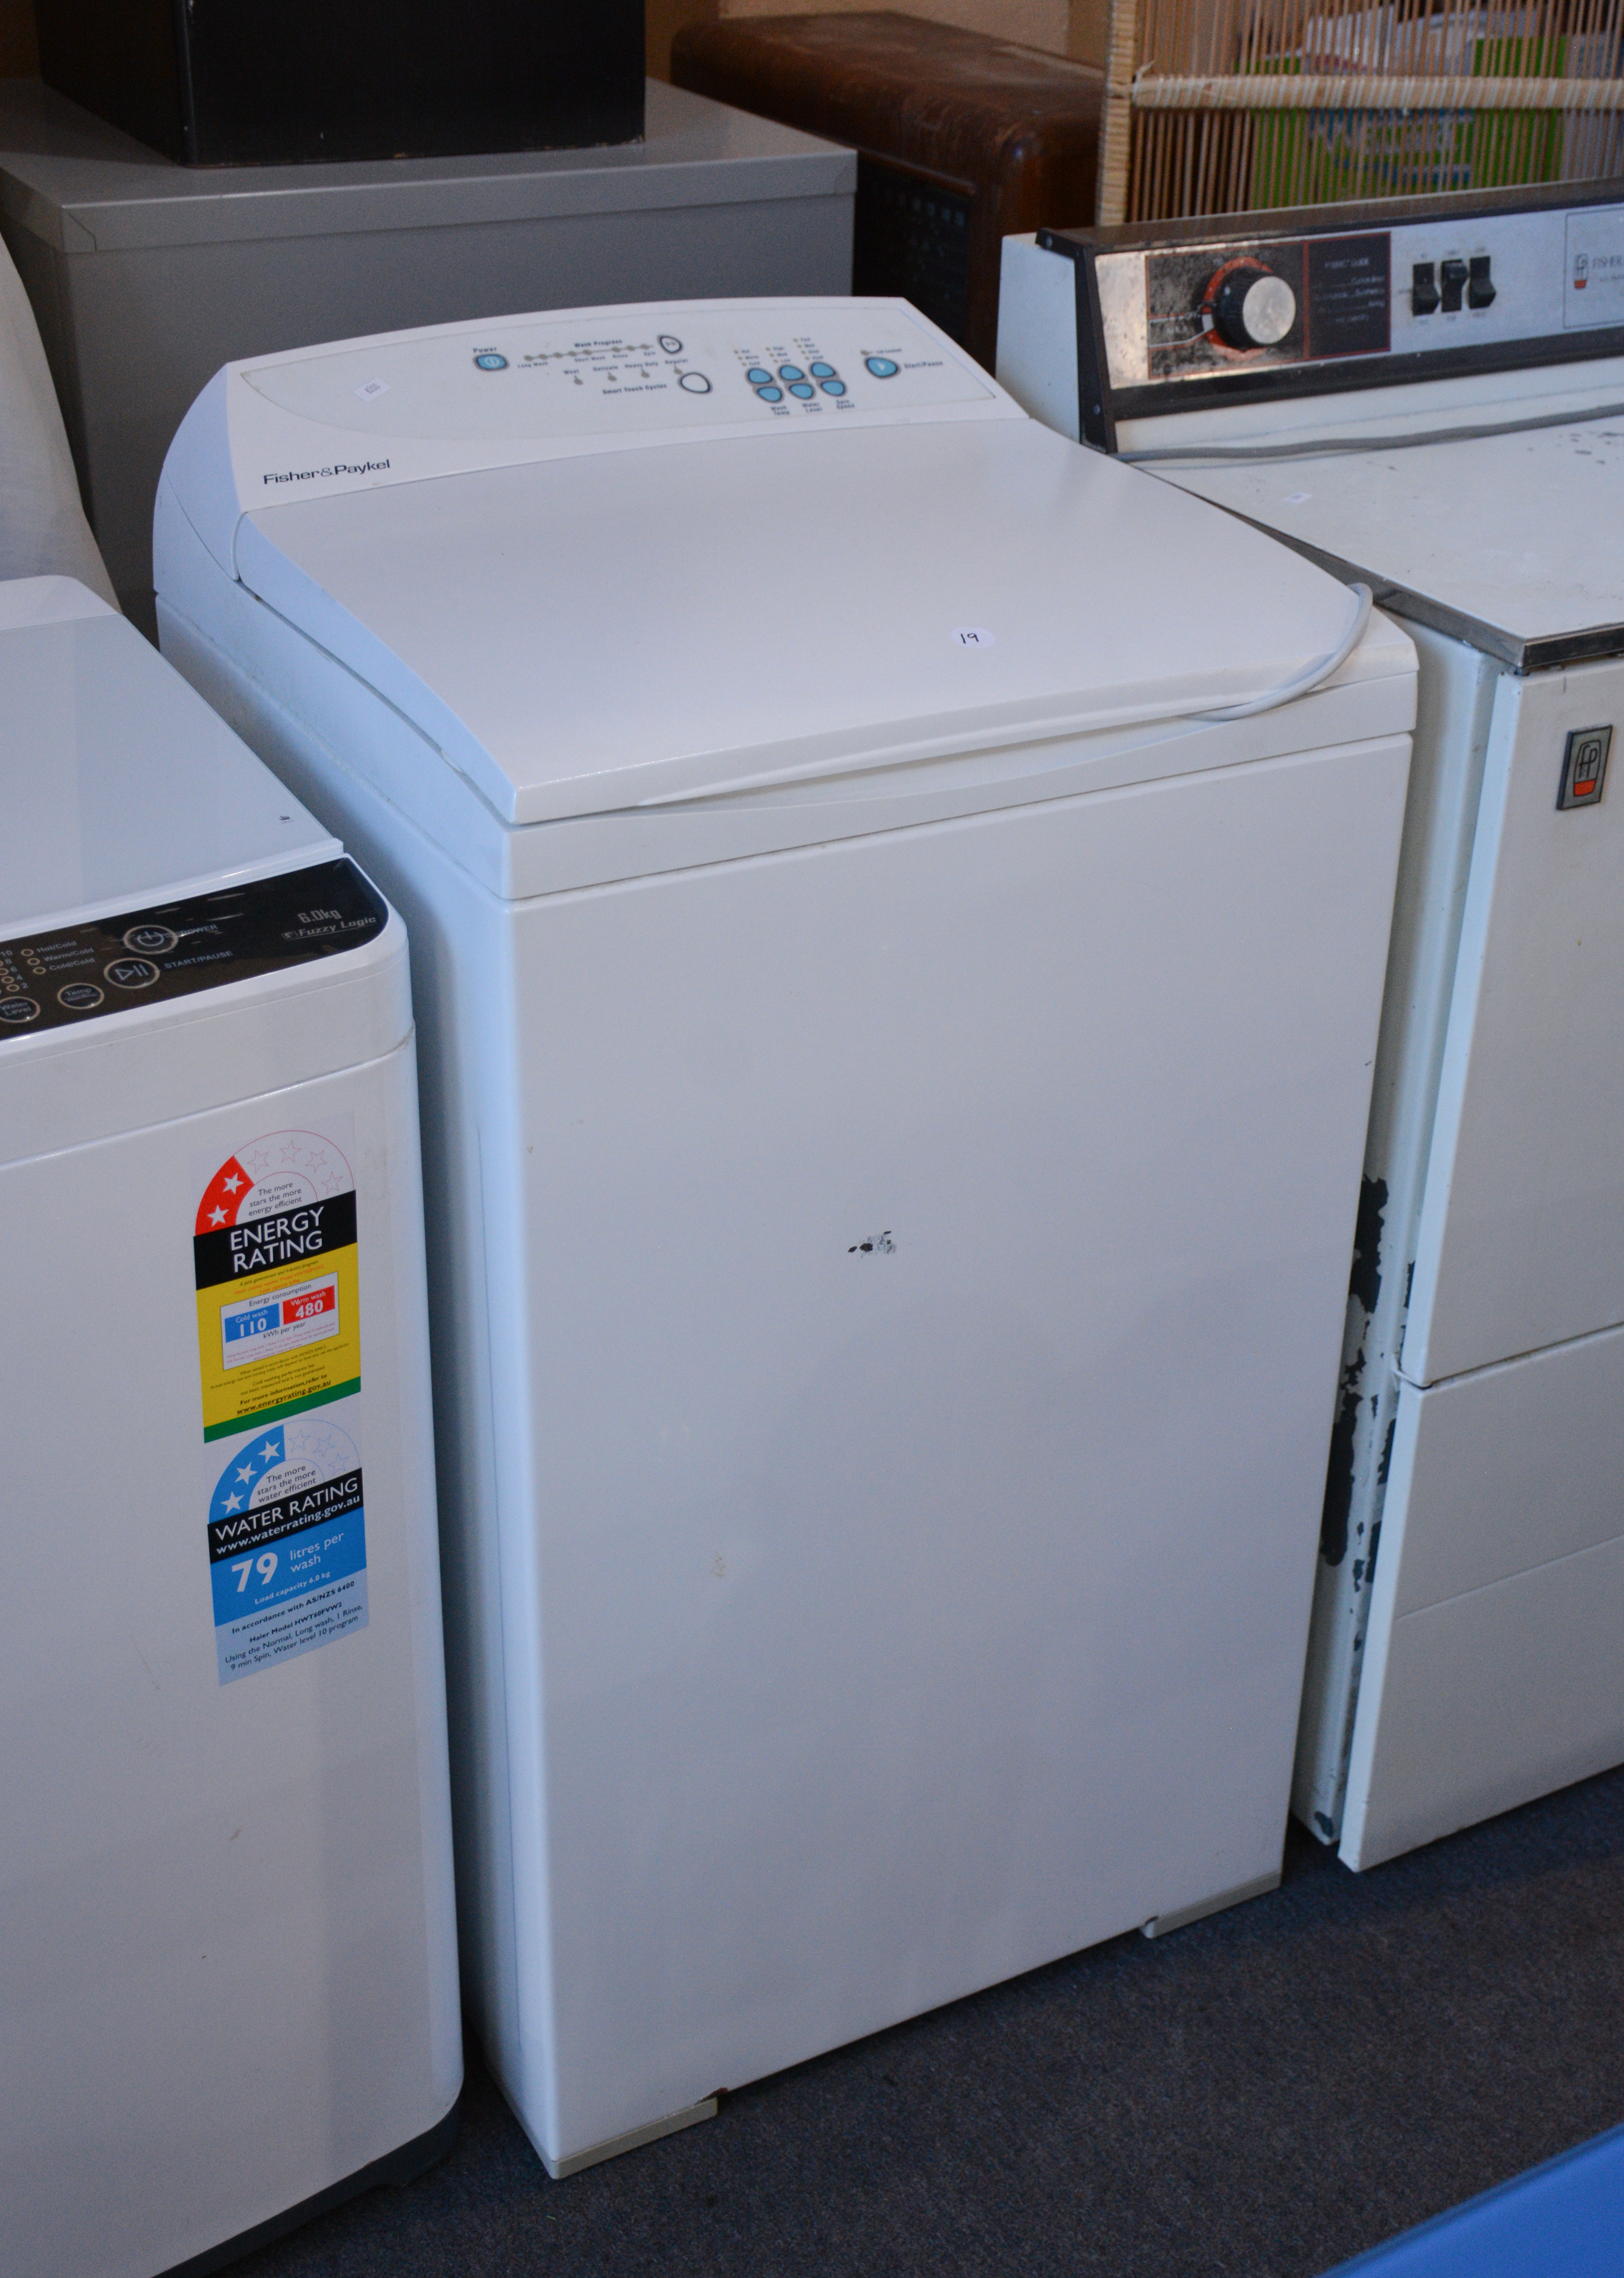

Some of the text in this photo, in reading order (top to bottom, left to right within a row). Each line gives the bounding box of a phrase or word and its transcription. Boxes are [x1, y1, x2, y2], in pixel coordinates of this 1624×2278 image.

[961, 633, 979, 644] 19
[297, 909, 342, 923] 6.0kg
[180, 924, 218, 935] POWER
[299, 925, 336, 936] Fuzzy
[341, 917, 376, 928] Logic
[36, 941, 77, 953] Hot/Cold
[43, 947, 94, 962] Warm/Cold
[49, 957, 95, 971] Cold/Cold
[164, 950, 234, 969] START/PAUSE
[5, 1007, 31, 1016] Level
[274, 1183, 293, 1192] more
[249, 1197, 302, 1216] energy efficient
[250, 1198, 266, 1207] stars
[283, 1189, 301, 1198] more
[230, 1206, 324, 1251] ENERGY
[234, 1231, 323, 1273] RATING
[249, 1284, 312, 1307] Energy consumption
[291, 1291, 326, 1306] Warm wash
[236, 1310, 268, 1323] Cold wash
[295, 1300, 323, 1318] 480
[240, 1318, 267, 1337] 110
[263, 1330, 279, 1339] kWh
[293, 1322, 306, 1331] year
[237, 1380, 331, 1415] www.energyrating.gov.au
[252, 1393, 268, 1402] more
[257, 1470, 316, 1495] stars the more
[267, 1466, 306, 1483] The more
[258, 1478, 316, 1503] water efficient
[215, 1477, 358, 1540] WATER RATING
[216, 1495, 360, 1554] www.waterrating.gov.au
[290, 1533, 344, 1561] litres per
[232, 1552, 278, 1592] 79
[290, 1554, 321, 1573] wash
[255, 1593, 274, 1604] Load
[276, 1581, 307, 1596] capacity
[309, 1575, 320, 1583] 6.0
[242, 1610, 285, 1630] accordance
[287, 1603, 304, 1613] with
[306, 1589, 336, 1605] AS/NZS
[337, 1581, 355, 1593] 6400
[250, 1602, 342, 1643] Haier Model HWT60FVW2
[225, 1651, 246, 1663] Using
[263, 1633, 293, 1649] Normal,
[295, 1626, 313, 1637] Long
[315, 1617, 334, 1628] wash,
[343, 1605, 362, 1617] Rinse,
[238, 1659, 252, 1668] min
[254, 1653, 271, 1662] Spin,
[274, 1641, 297, 1654] Water
[300, 1632, 315, 1644] level
[329, 1616, 358, 1634] program
